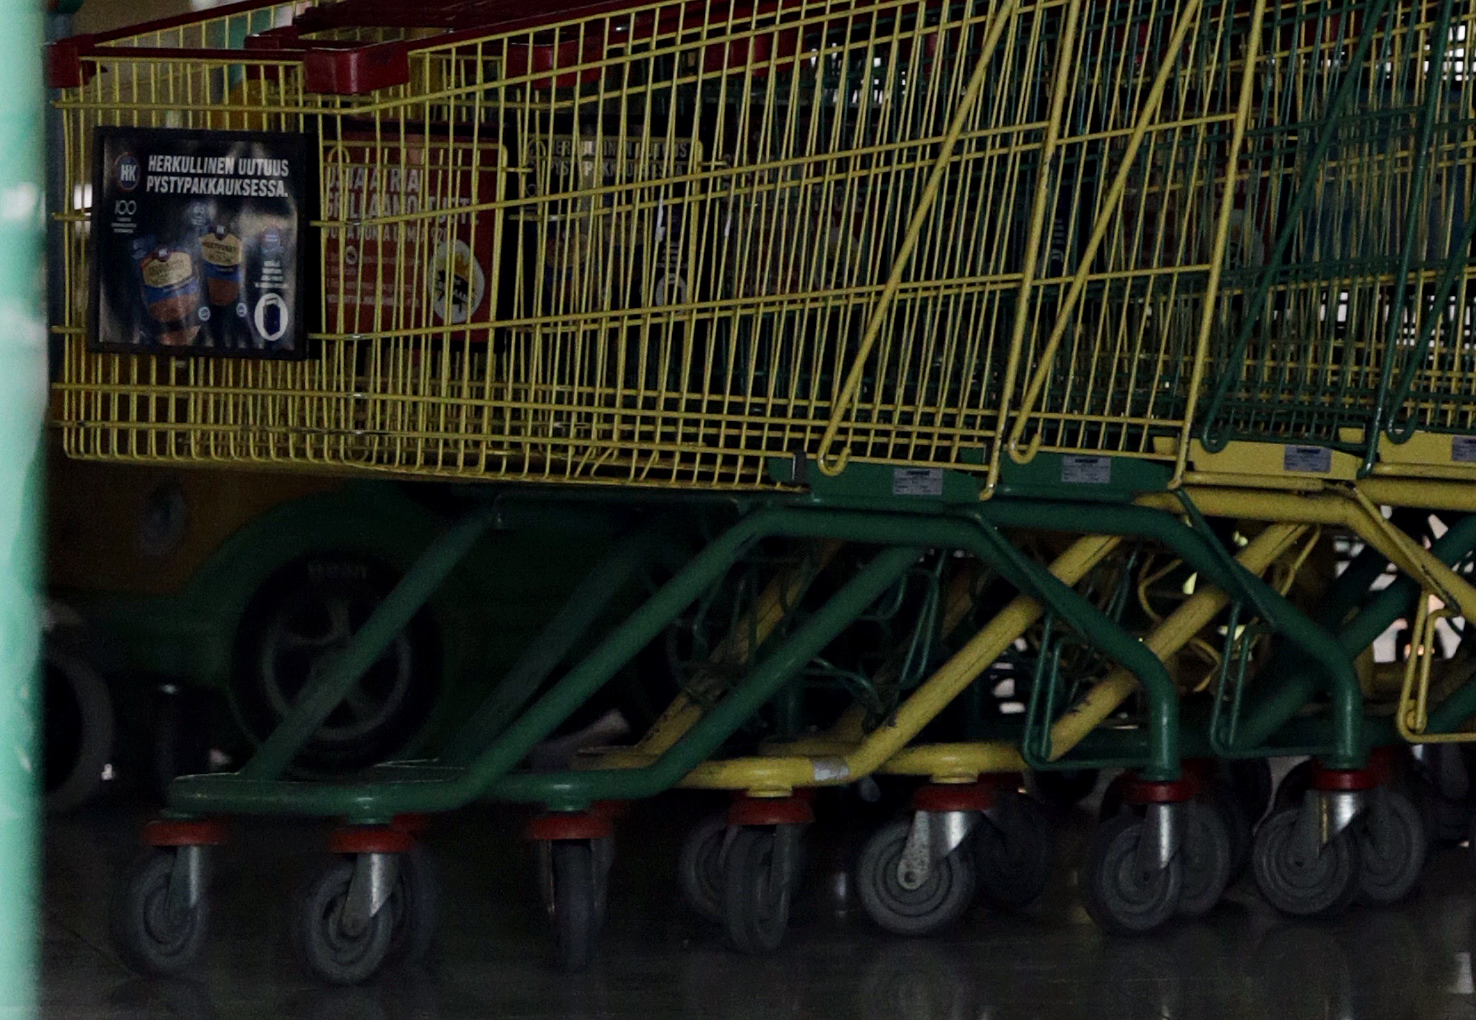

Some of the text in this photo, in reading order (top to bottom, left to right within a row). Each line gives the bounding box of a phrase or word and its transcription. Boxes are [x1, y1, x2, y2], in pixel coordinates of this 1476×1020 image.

[120, 164, 137, 182] HK
[147, 154, 290, 177] HERKULLINEN UUTUUS
[146, 175, 289, 198] PYSTYPAKKAUKSESSA.
